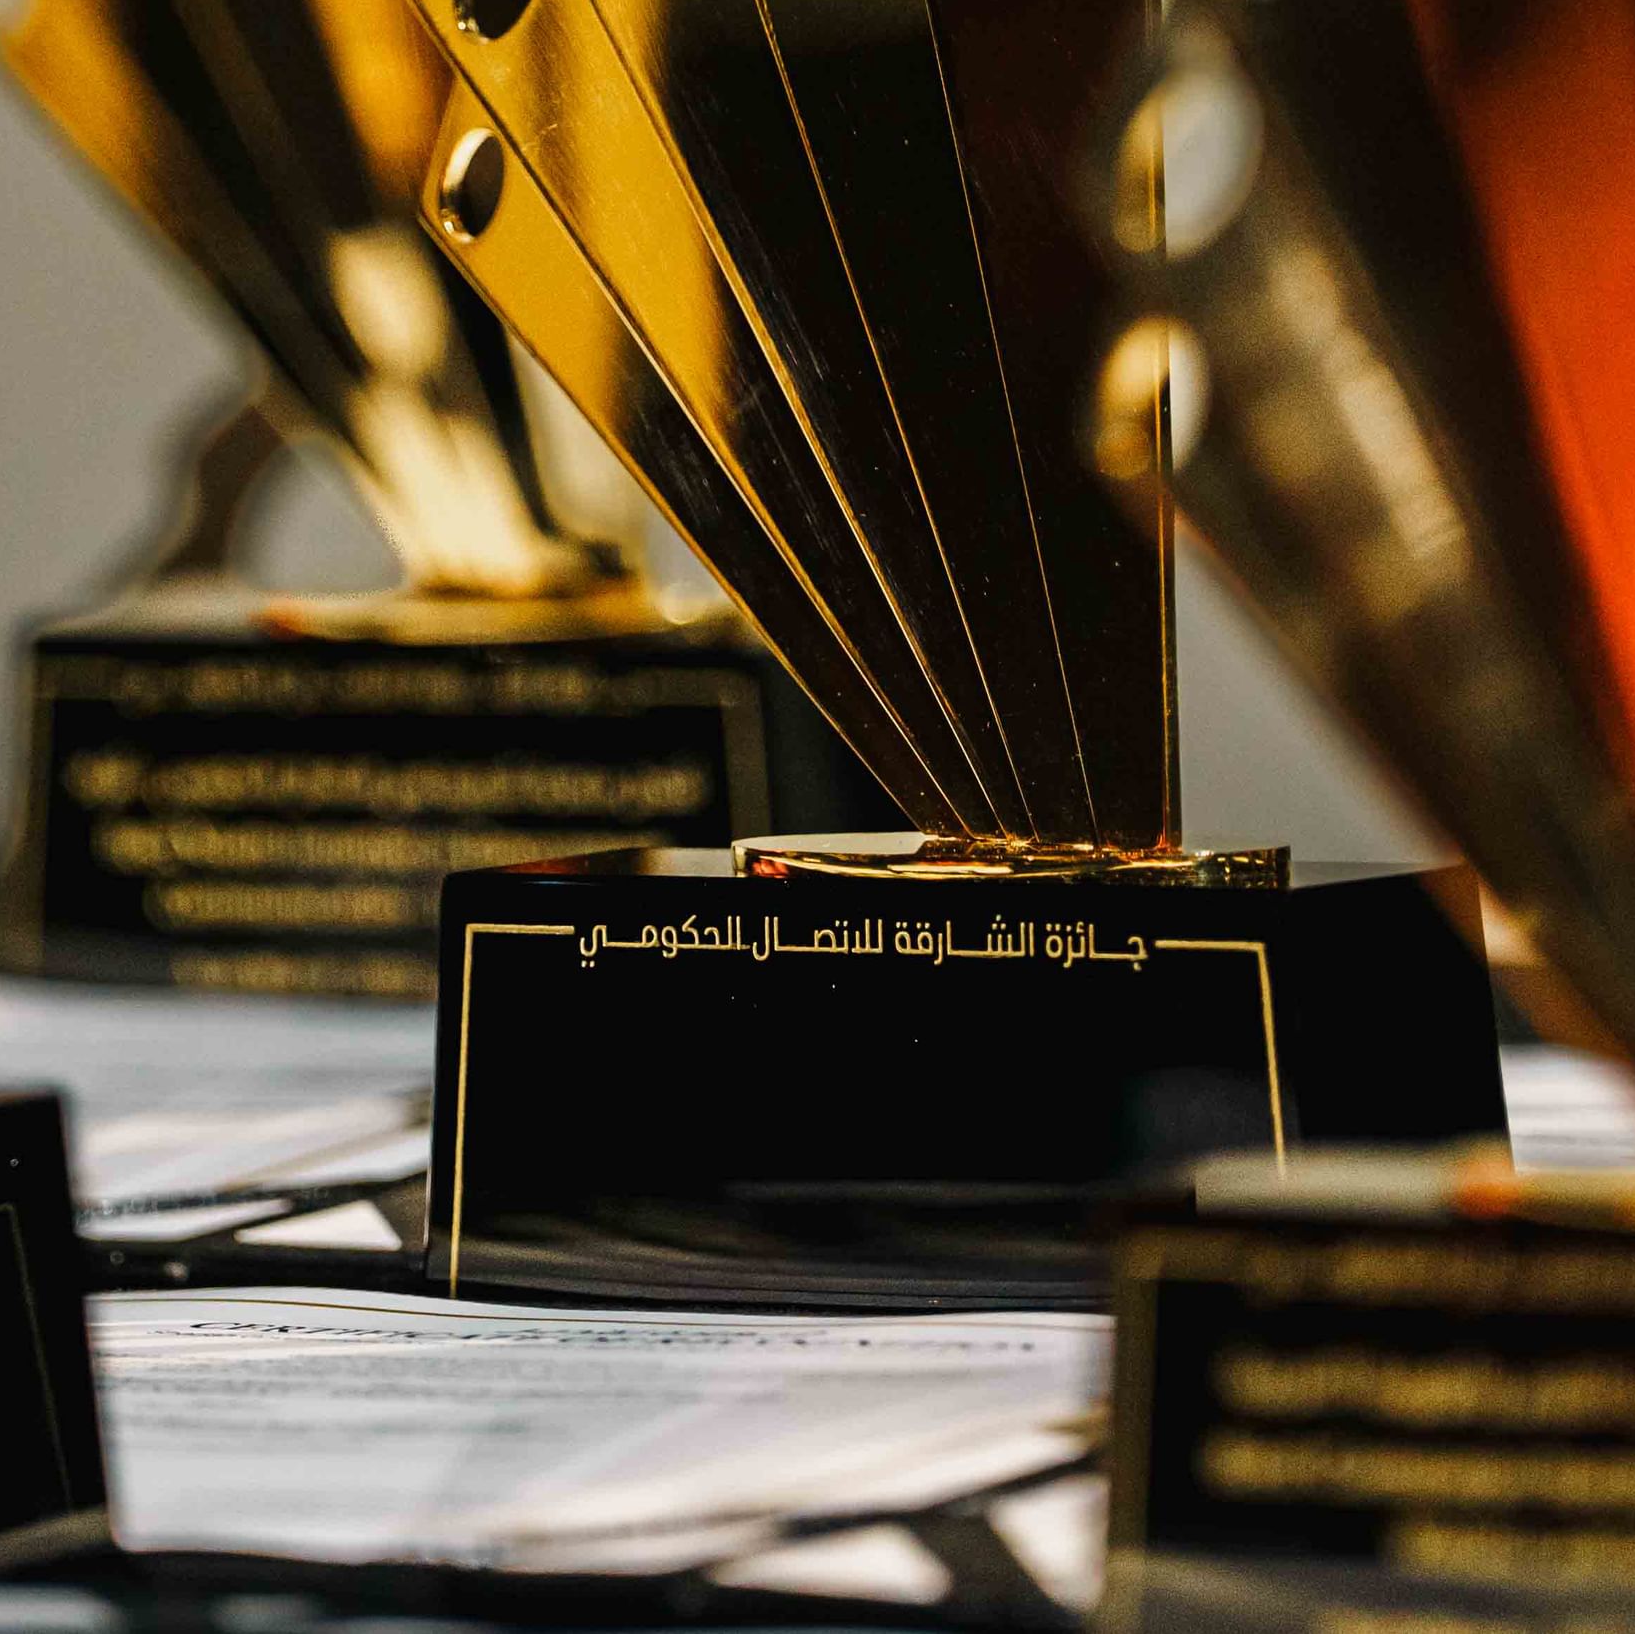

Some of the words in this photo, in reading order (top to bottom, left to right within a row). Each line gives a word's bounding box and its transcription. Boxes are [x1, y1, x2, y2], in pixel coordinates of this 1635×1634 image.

[580, 915, 748, 968] الحكومي
[753, 916, 883, 961] للاتصال
[895, 914, 1034, 965] الشارقة
[1045, 921, 1148, 970] جائزة
